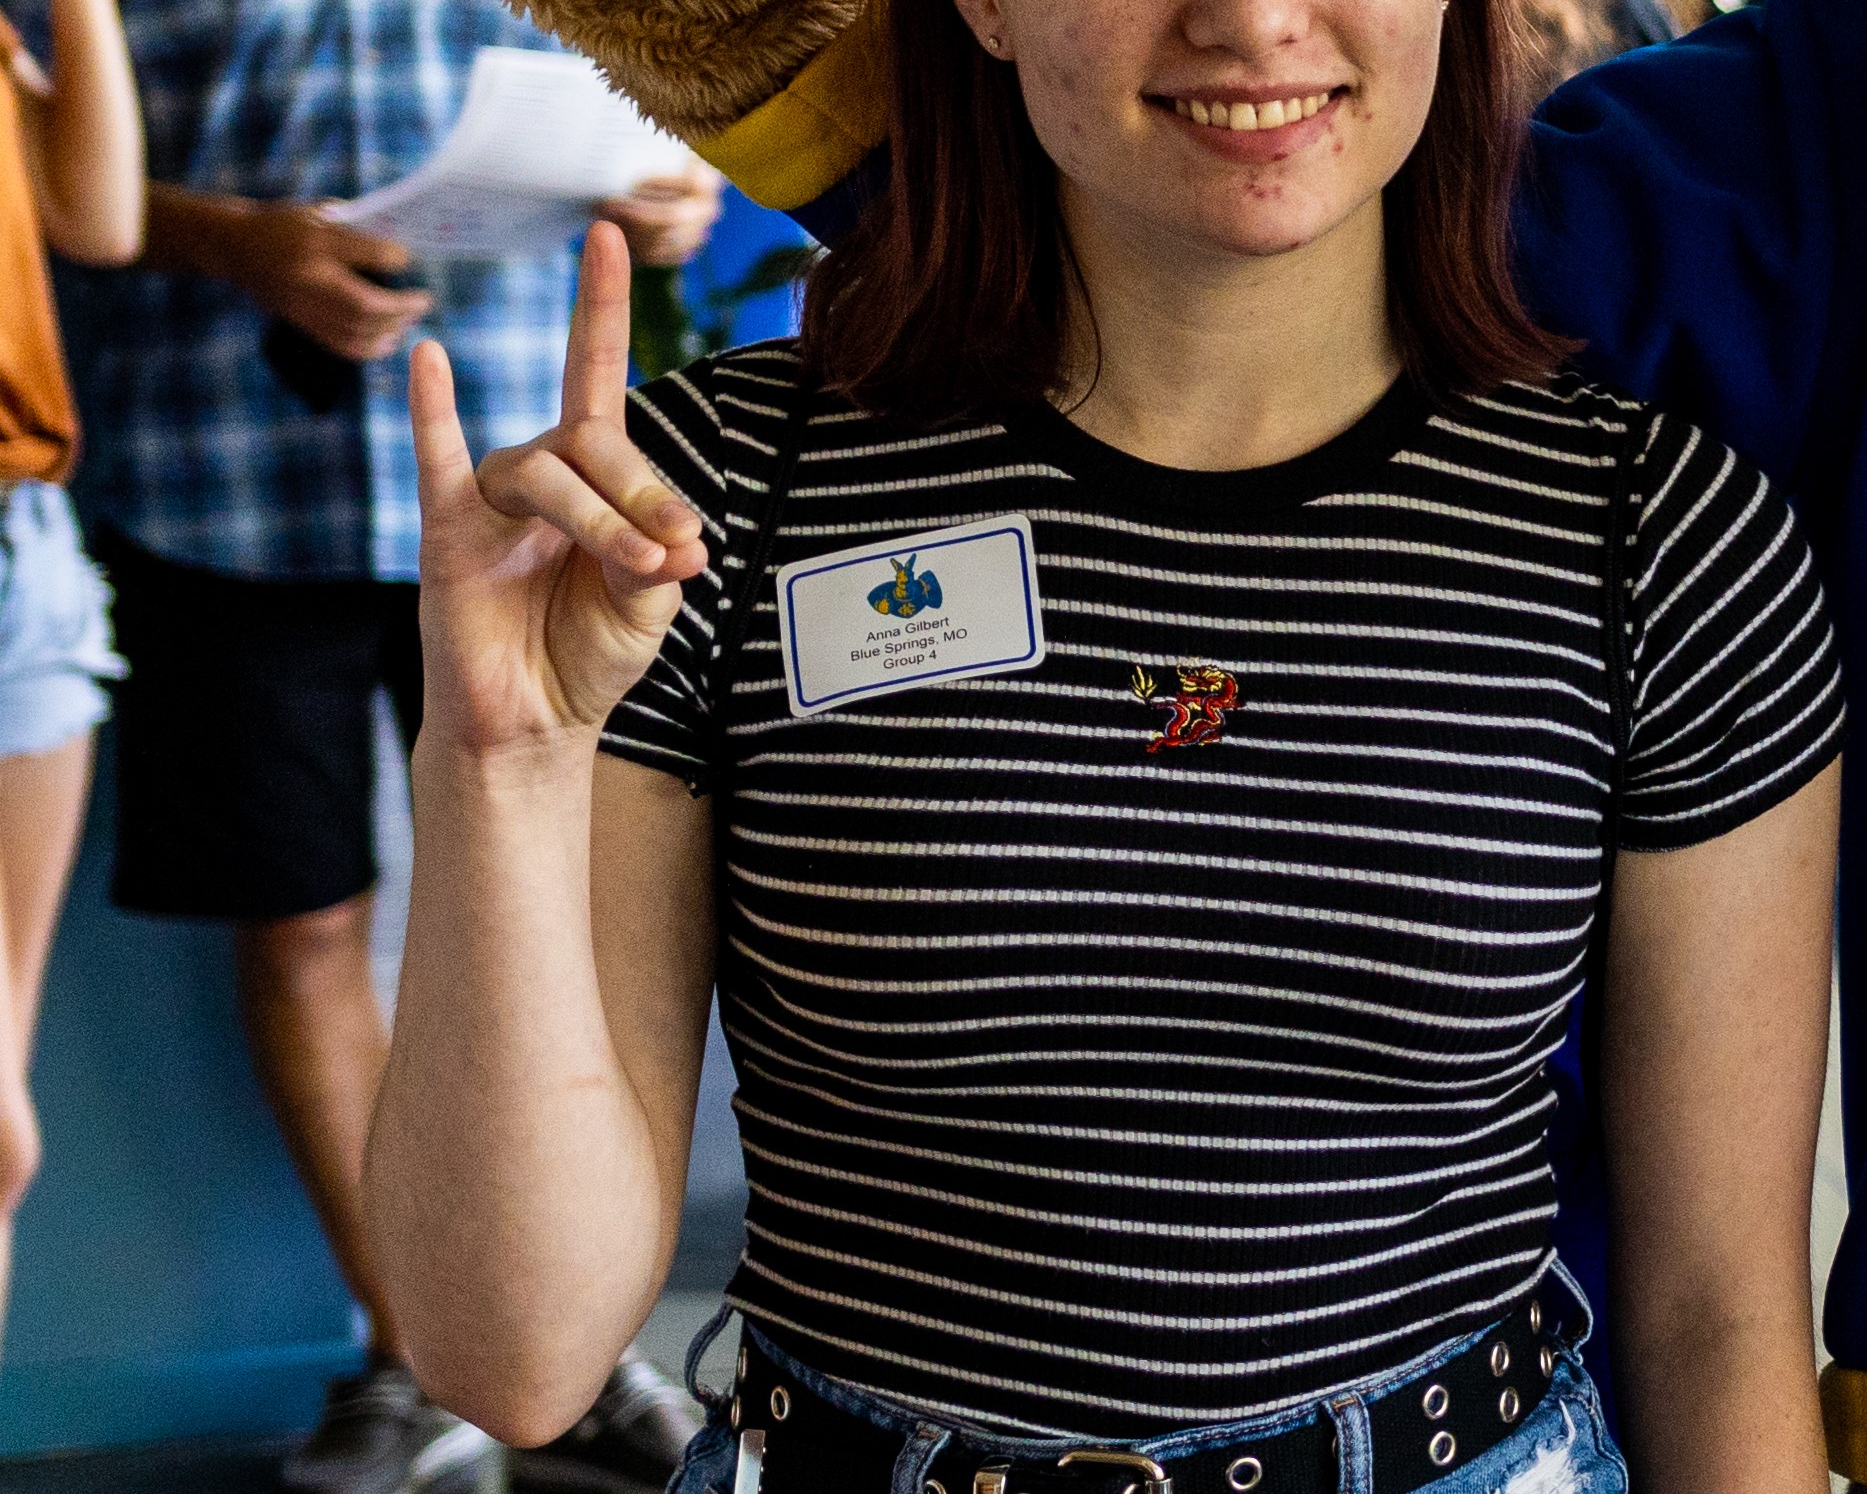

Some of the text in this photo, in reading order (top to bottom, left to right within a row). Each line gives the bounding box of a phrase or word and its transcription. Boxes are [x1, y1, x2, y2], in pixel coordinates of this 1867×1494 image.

[865, 616, 950, 643] Anna Gilbert
[850, 628, 968, 662] Blue Springs, MO
[882, 649, 937, 669] Group 4
